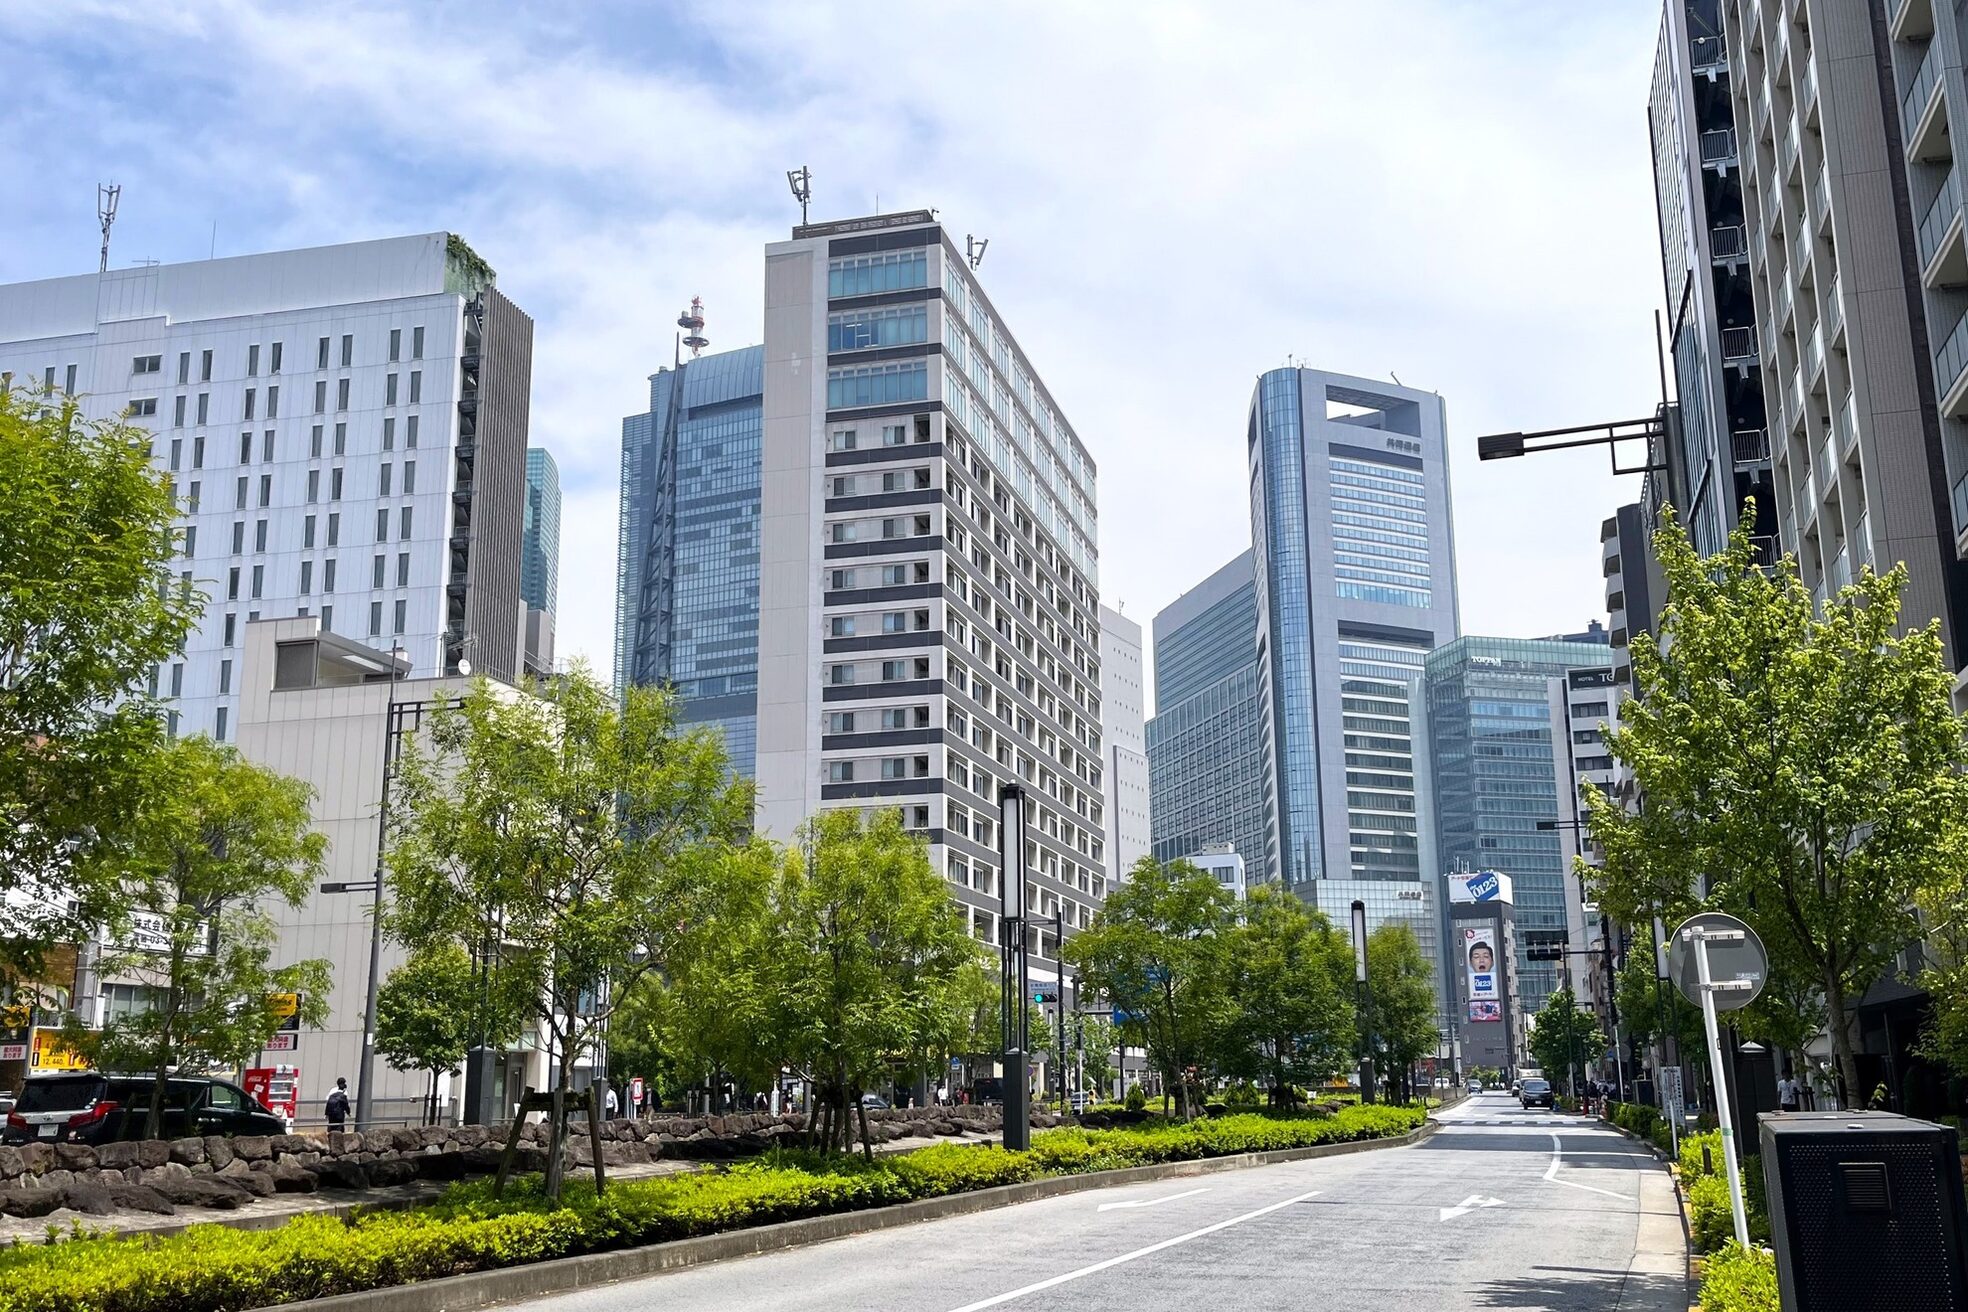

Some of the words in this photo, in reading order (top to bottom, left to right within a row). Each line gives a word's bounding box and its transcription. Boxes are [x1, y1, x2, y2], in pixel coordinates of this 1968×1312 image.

[1471, 655, 1501, 667] TOPPAN
[1472, 876, 1498, 898] 0123
[1474, 979, 1492, 988] 0123
